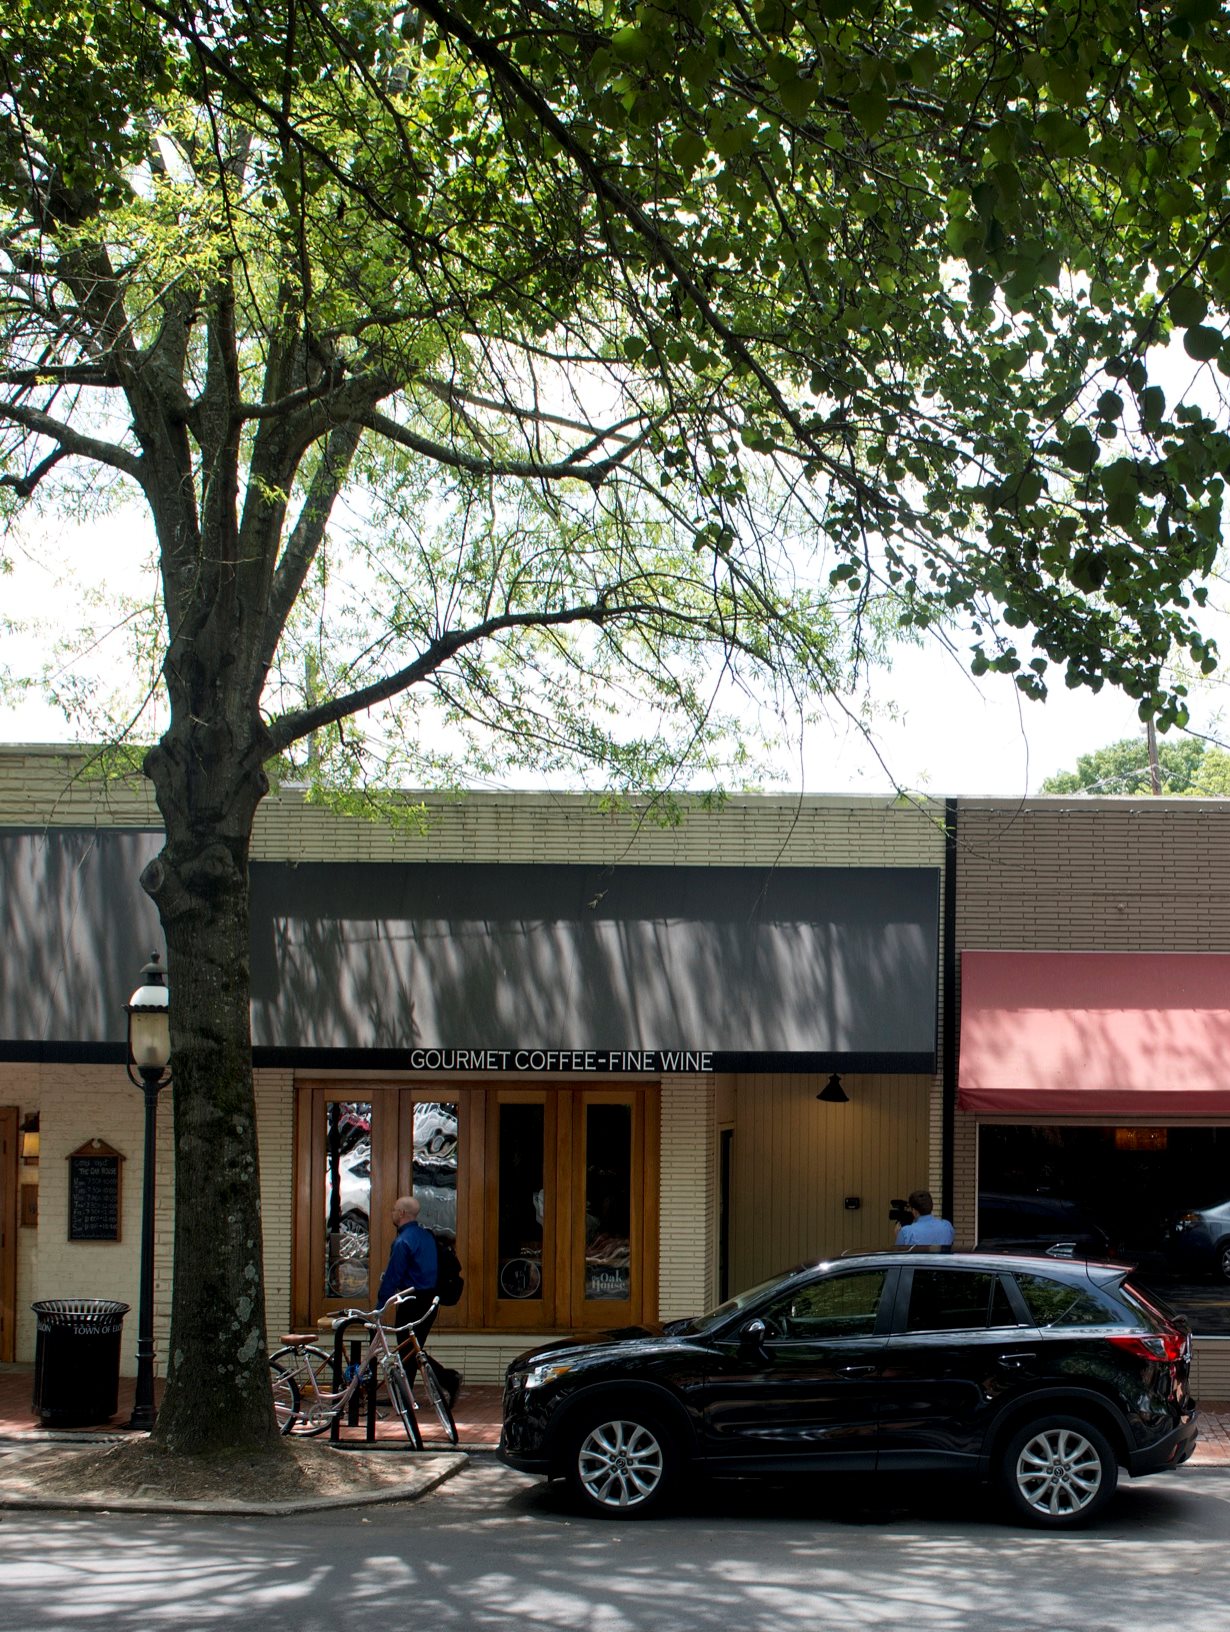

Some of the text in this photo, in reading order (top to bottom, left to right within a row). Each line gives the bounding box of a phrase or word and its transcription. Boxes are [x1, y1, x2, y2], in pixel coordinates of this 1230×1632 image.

[410, 1049, 714, 1071] GOURMET COFFEE-FINE WINE
[600, 1270, 624, 1282] Oak
[73, 1327, 100, 1335] TOWN
[101, 1326, 111, 1334] OF
